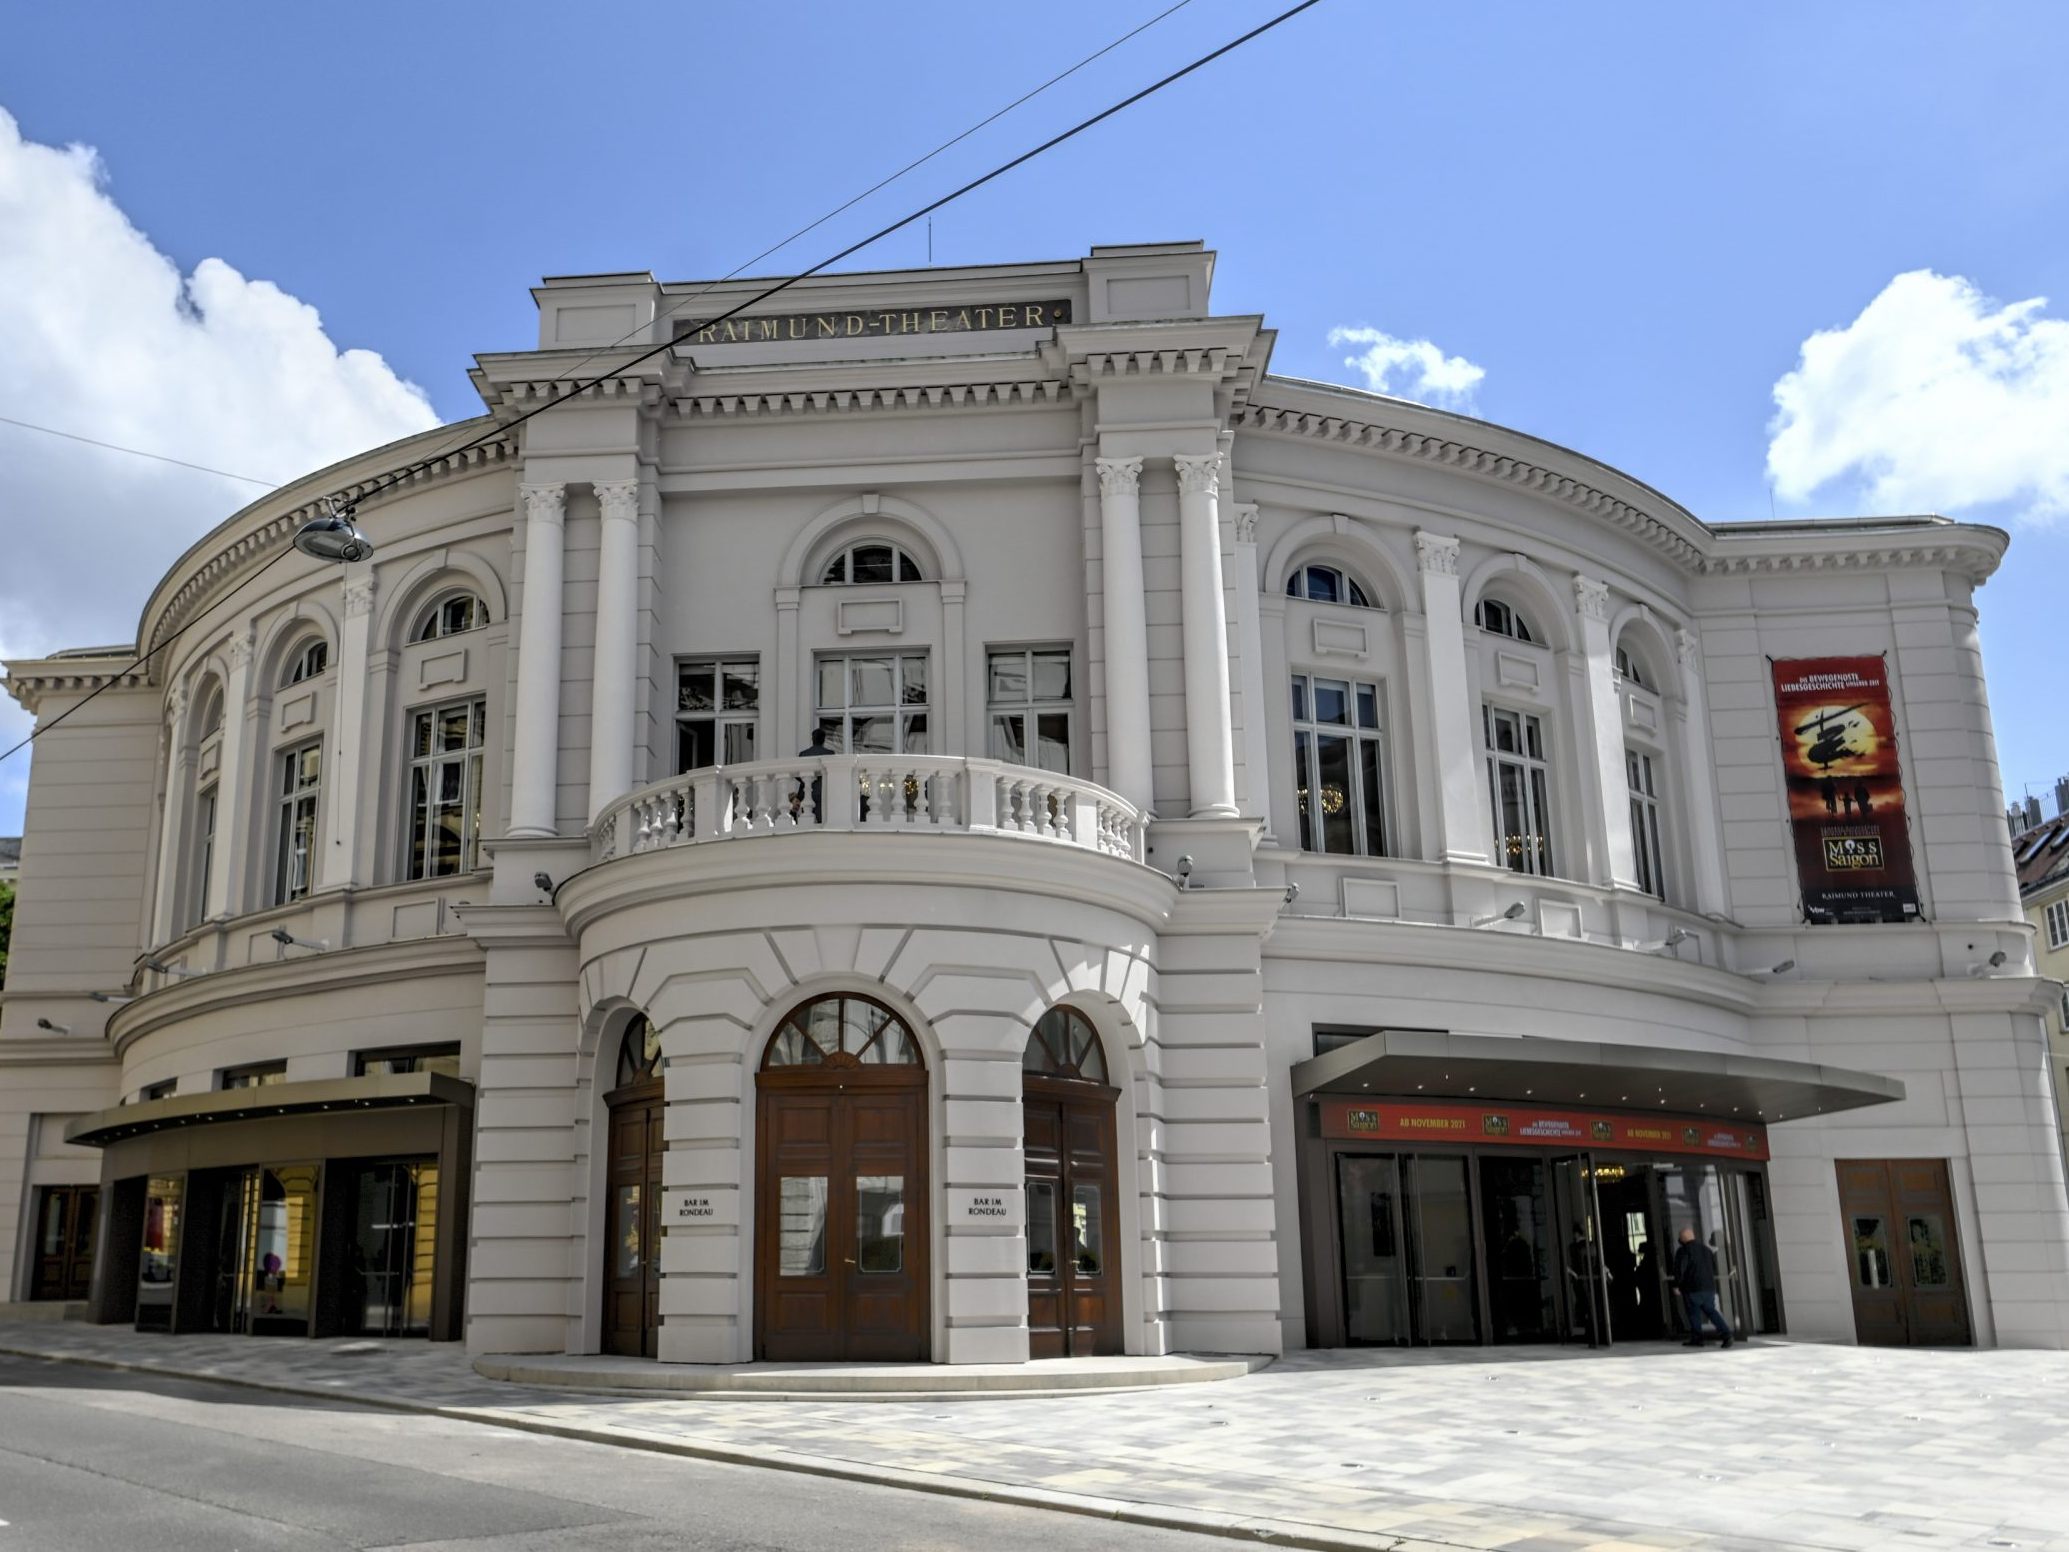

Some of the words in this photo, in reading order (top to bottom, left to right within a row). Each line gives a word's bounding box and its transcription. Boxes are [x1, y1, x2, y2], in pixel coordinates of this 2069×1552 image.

[700, 305, 1044, 343] RAIMUND-THEATER
[1781, 681, 1845, 692] LIEBESGESCHICHTE
[1830, 853, 1879, 869] Saigon
[1822, 892, 1859, 900] RAIMUND
[1861, 891, 1894, 899] THEATER
[1400, 1118, 1409, 1127] AB
[1411, 1119, 1449, 1128] NOVEMBER
[1451, 1120, 1466, 1129] 2021
[974, 1198, 990, 1206] BAR
[991, 1198, 1002, 1206] IM
[680, 1208, 713, 1216] RONDEAU
[968, 1207, 1007, 1216] RONDEAU
